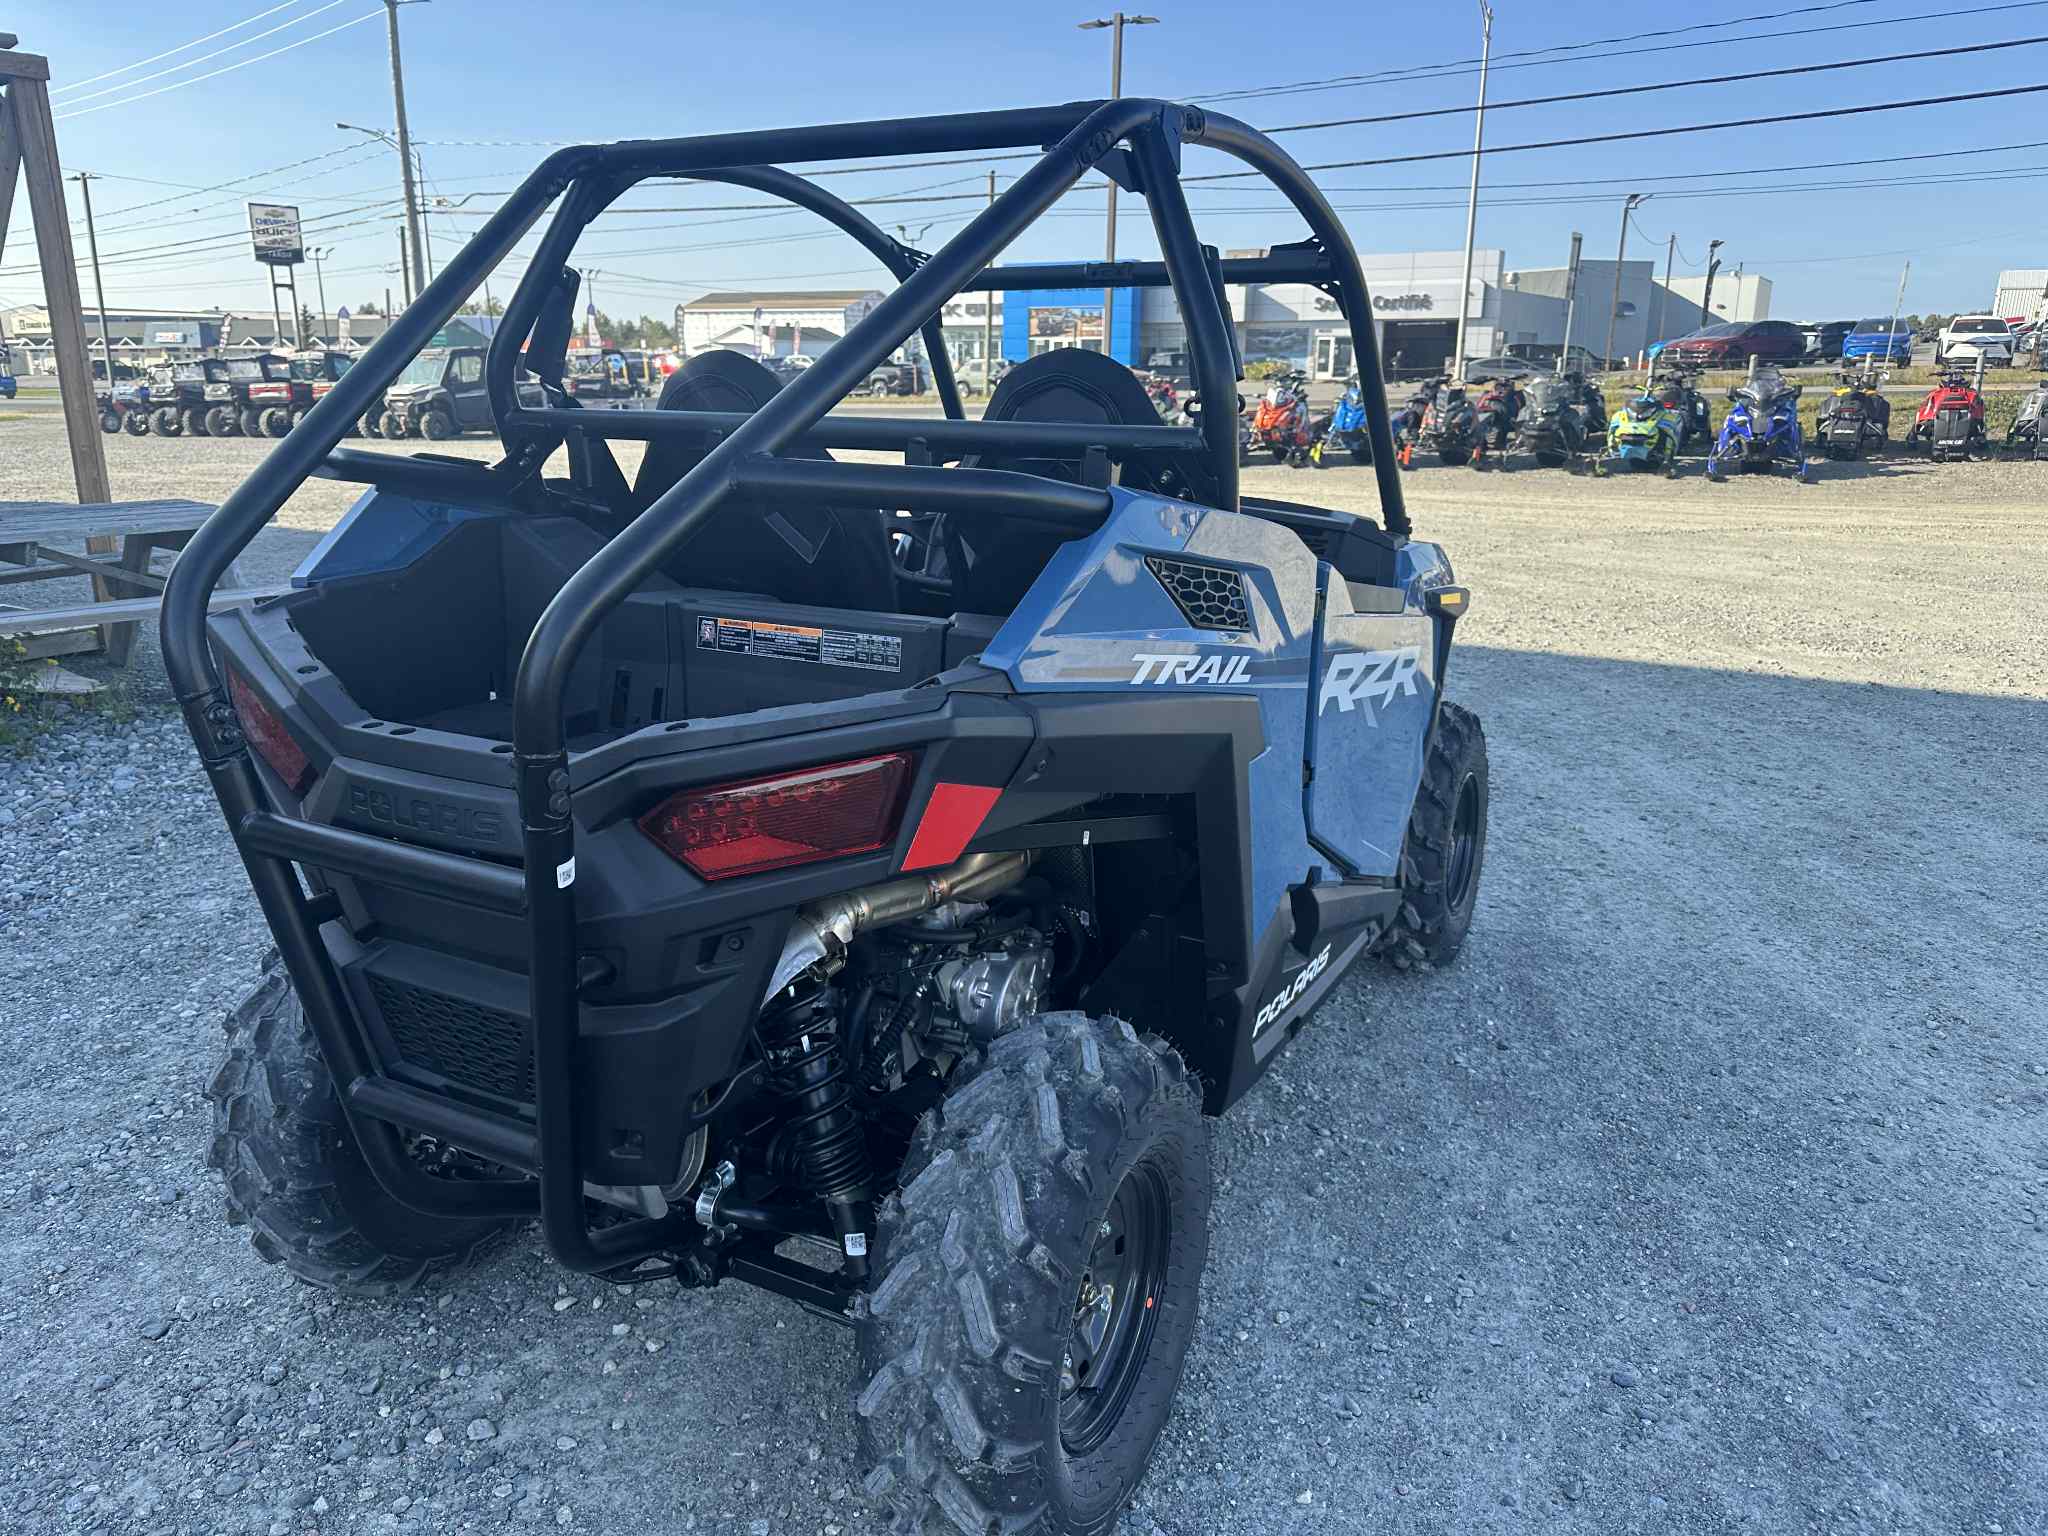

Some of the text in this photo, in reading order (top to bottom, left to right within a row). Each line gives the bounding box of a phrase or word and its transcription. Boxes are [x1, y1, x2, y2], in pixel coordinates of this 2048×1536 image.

[1129, 653, 1252, 685] TRAIL
[1318, 645, 1422, 718] RZR
[349, 783, 504, 843] POLARIS
[1251, 940, 1332, 1038] POLARIS
